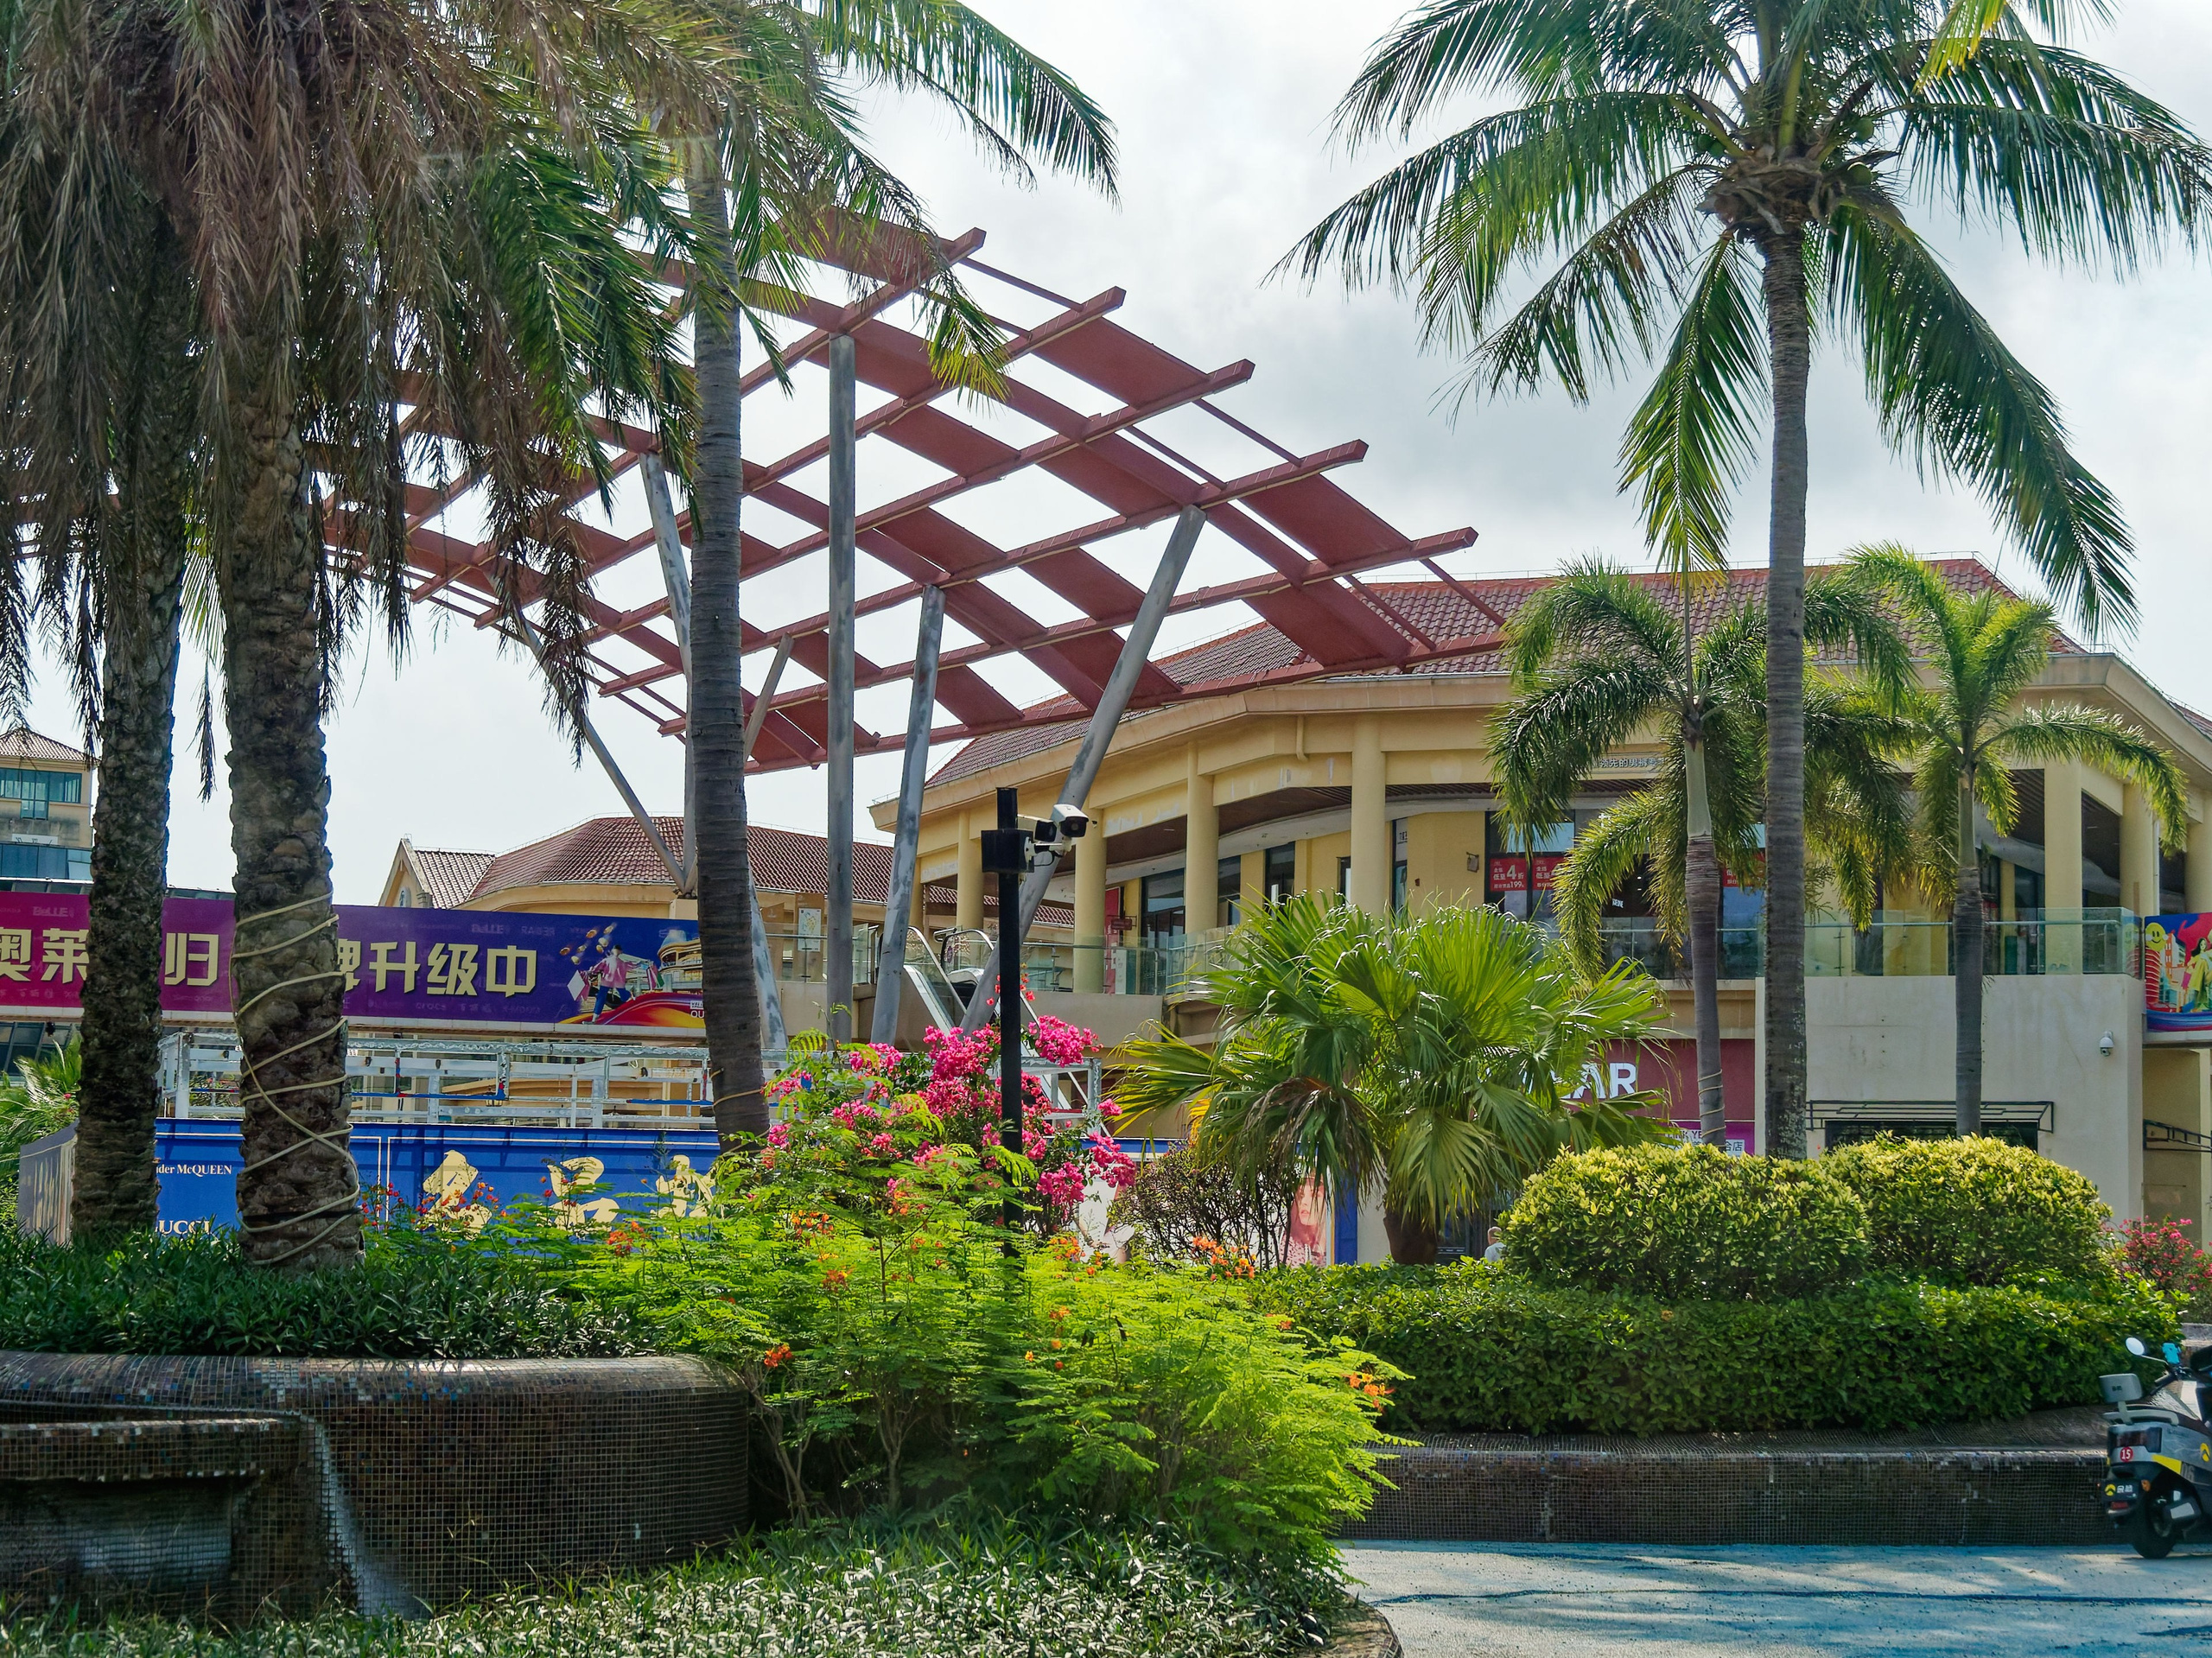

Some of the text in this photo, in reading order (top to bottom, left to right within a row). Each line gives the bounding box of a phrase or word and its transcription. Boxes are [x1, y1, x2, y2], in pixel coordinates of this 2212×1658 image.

[176, 1164, 232, 1178] McQUEEN
[156, 1219, 211, 1236] UCCI
[2121, 1449, 2131, 1460] 15
